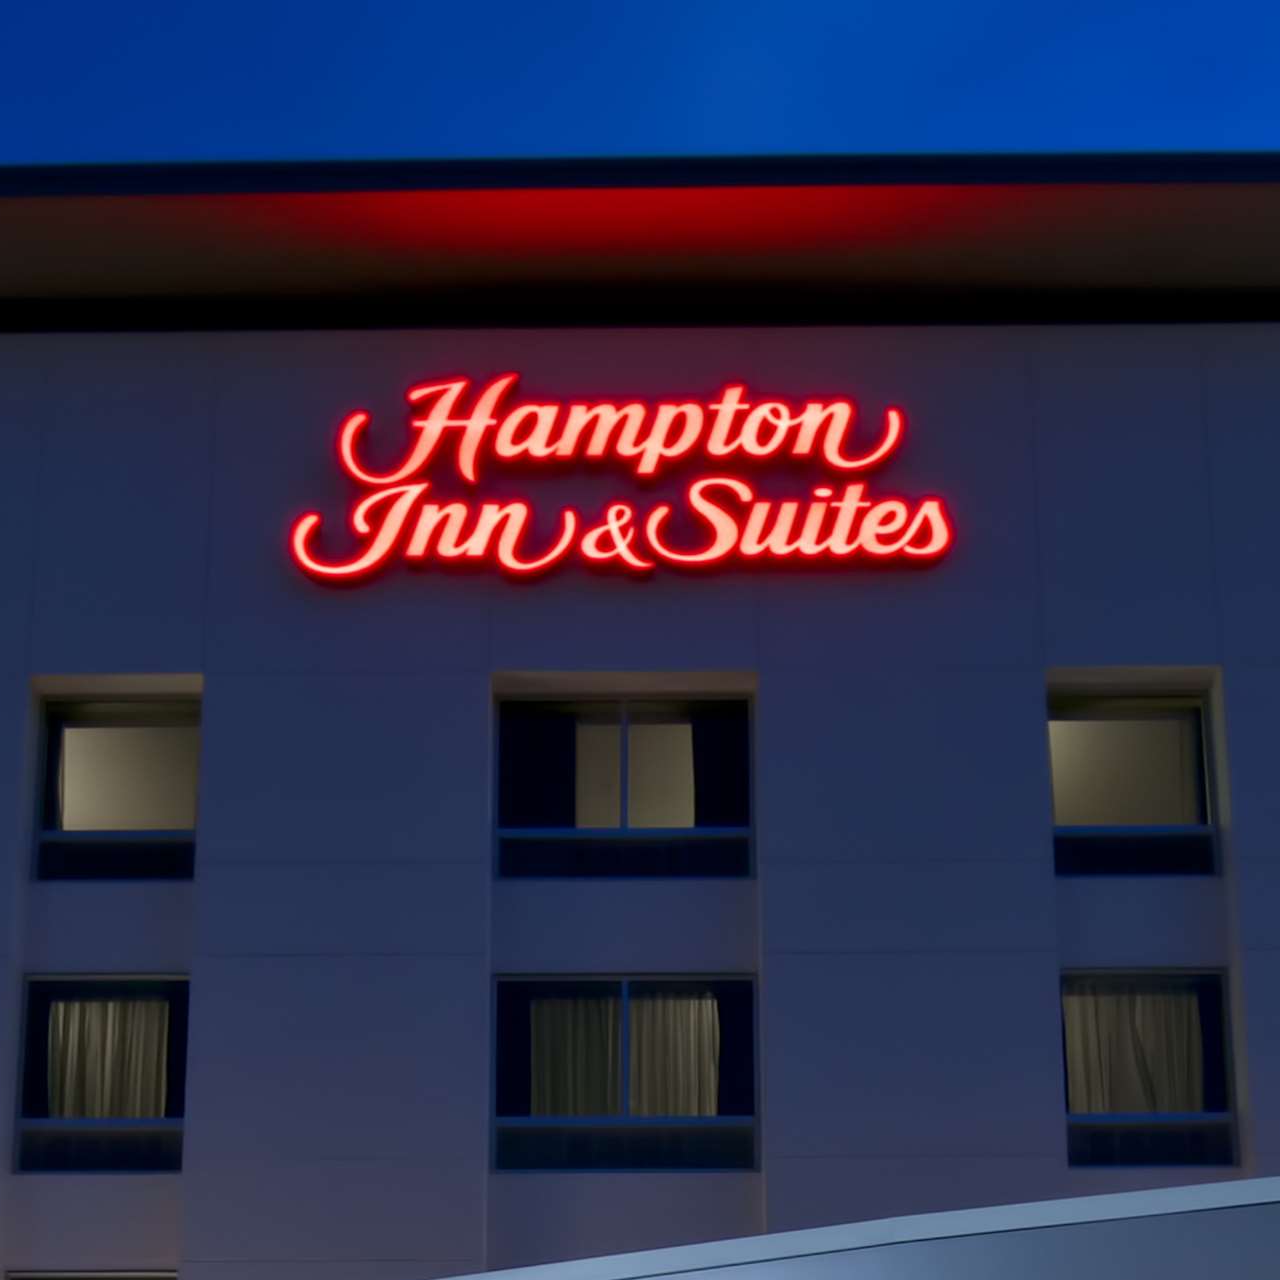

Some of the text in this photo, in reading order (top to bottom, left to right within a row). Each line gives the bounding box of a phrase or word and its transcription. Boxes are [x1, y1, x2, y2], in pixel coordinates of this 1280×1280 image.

[337, 373, 904, 485] Hampton
[290, 475, 952, 577] Inn & Suites
